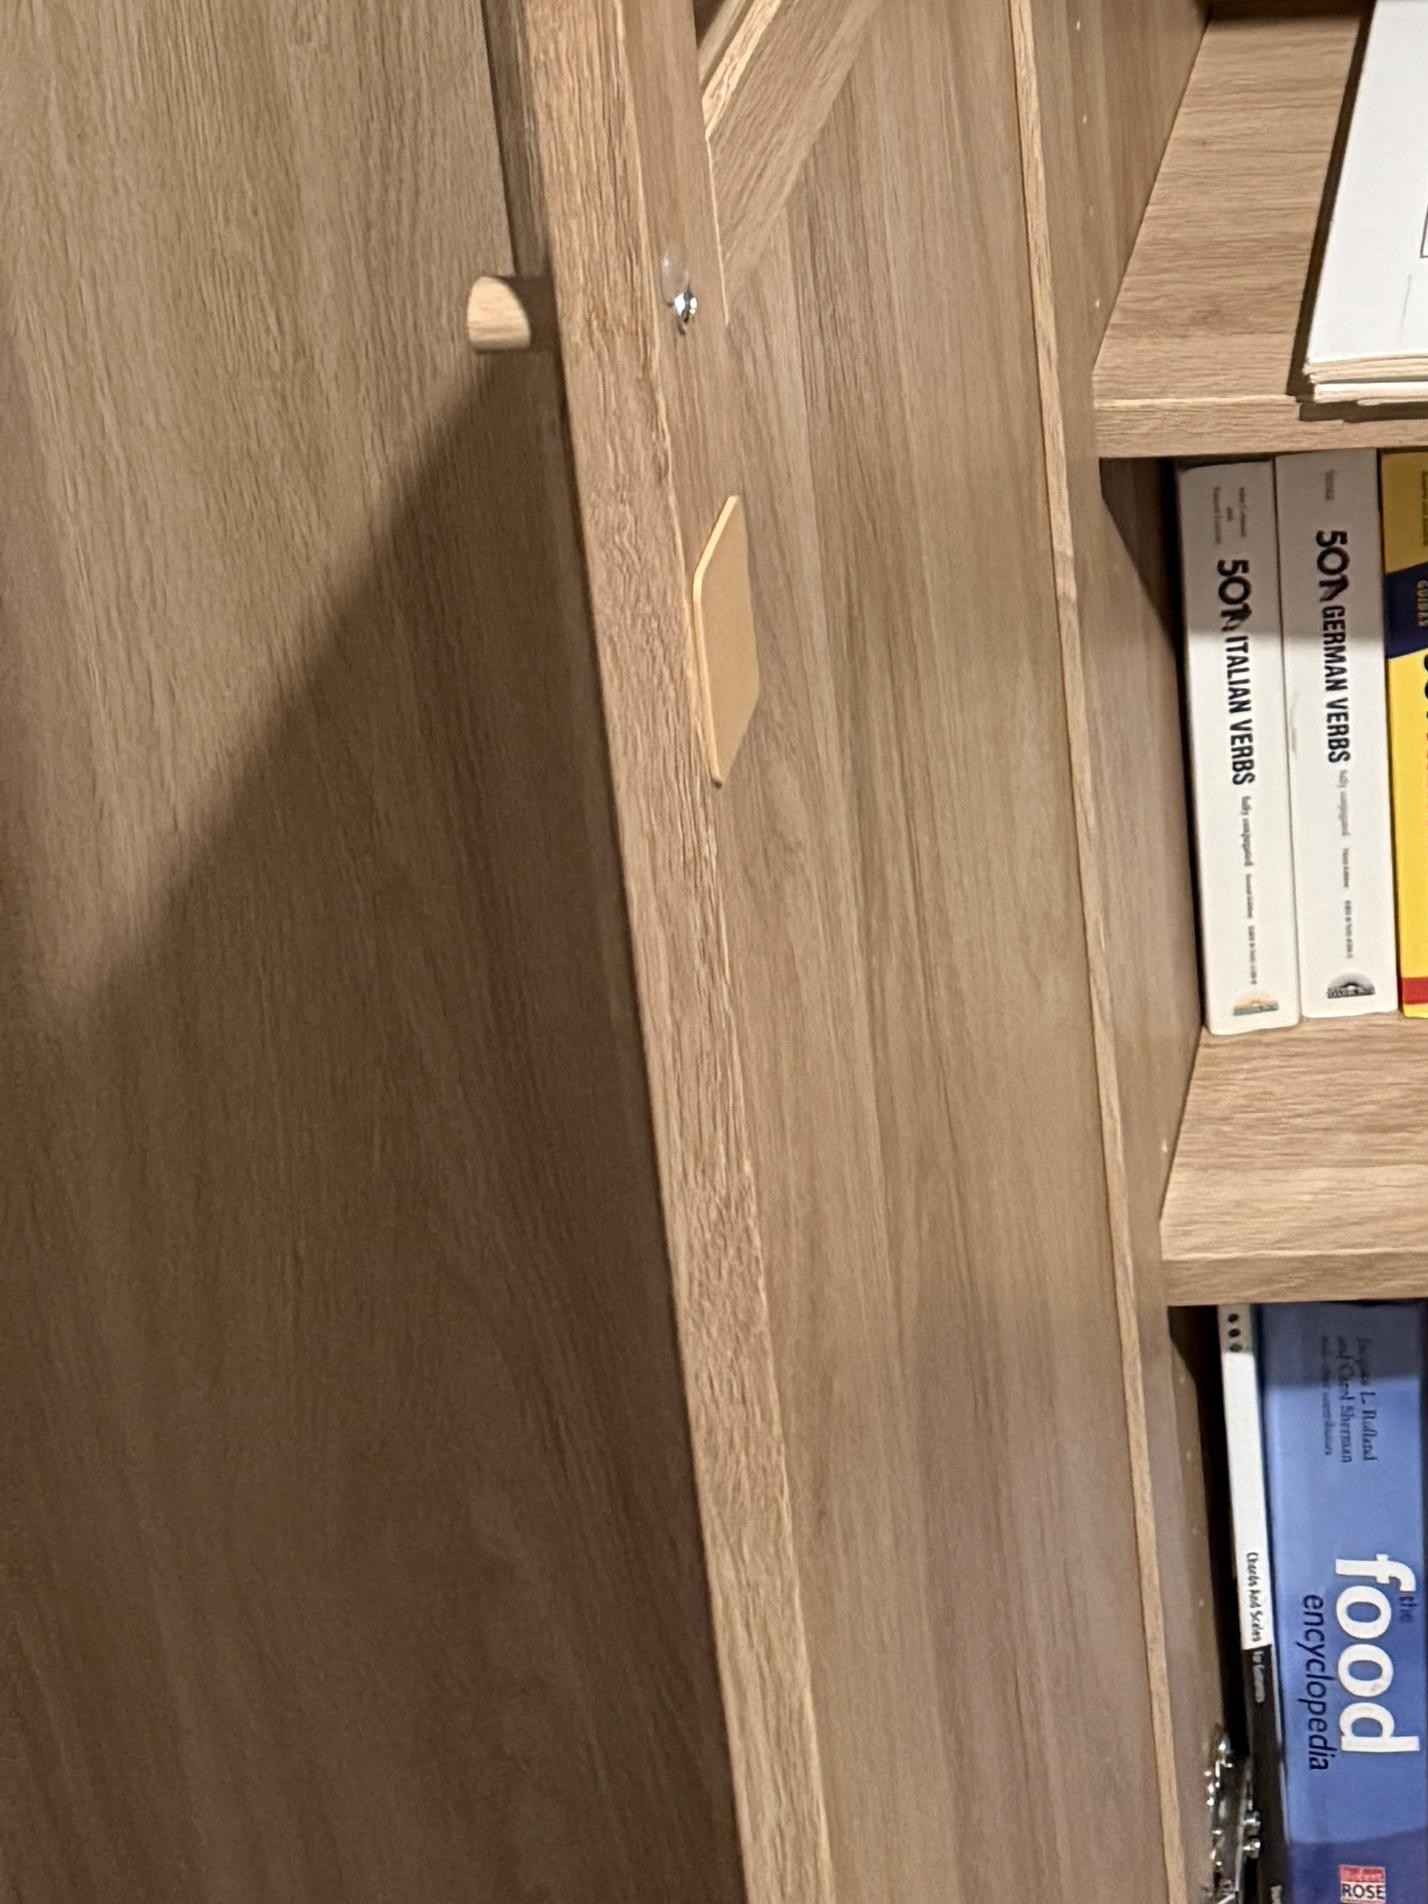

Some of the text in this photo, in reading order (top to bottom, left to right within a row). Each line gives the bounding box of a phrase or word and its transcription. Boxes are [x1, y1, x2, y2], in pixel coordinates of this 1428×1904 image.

[1224, 633, 1257, 788] ITALIAN VERBS
[1321, 604, 1351, 765] GERMAN VERBS
[1302, 1593, 1332, 1773] encyclopedia
[1334, 1552, 1421, 1754] food
